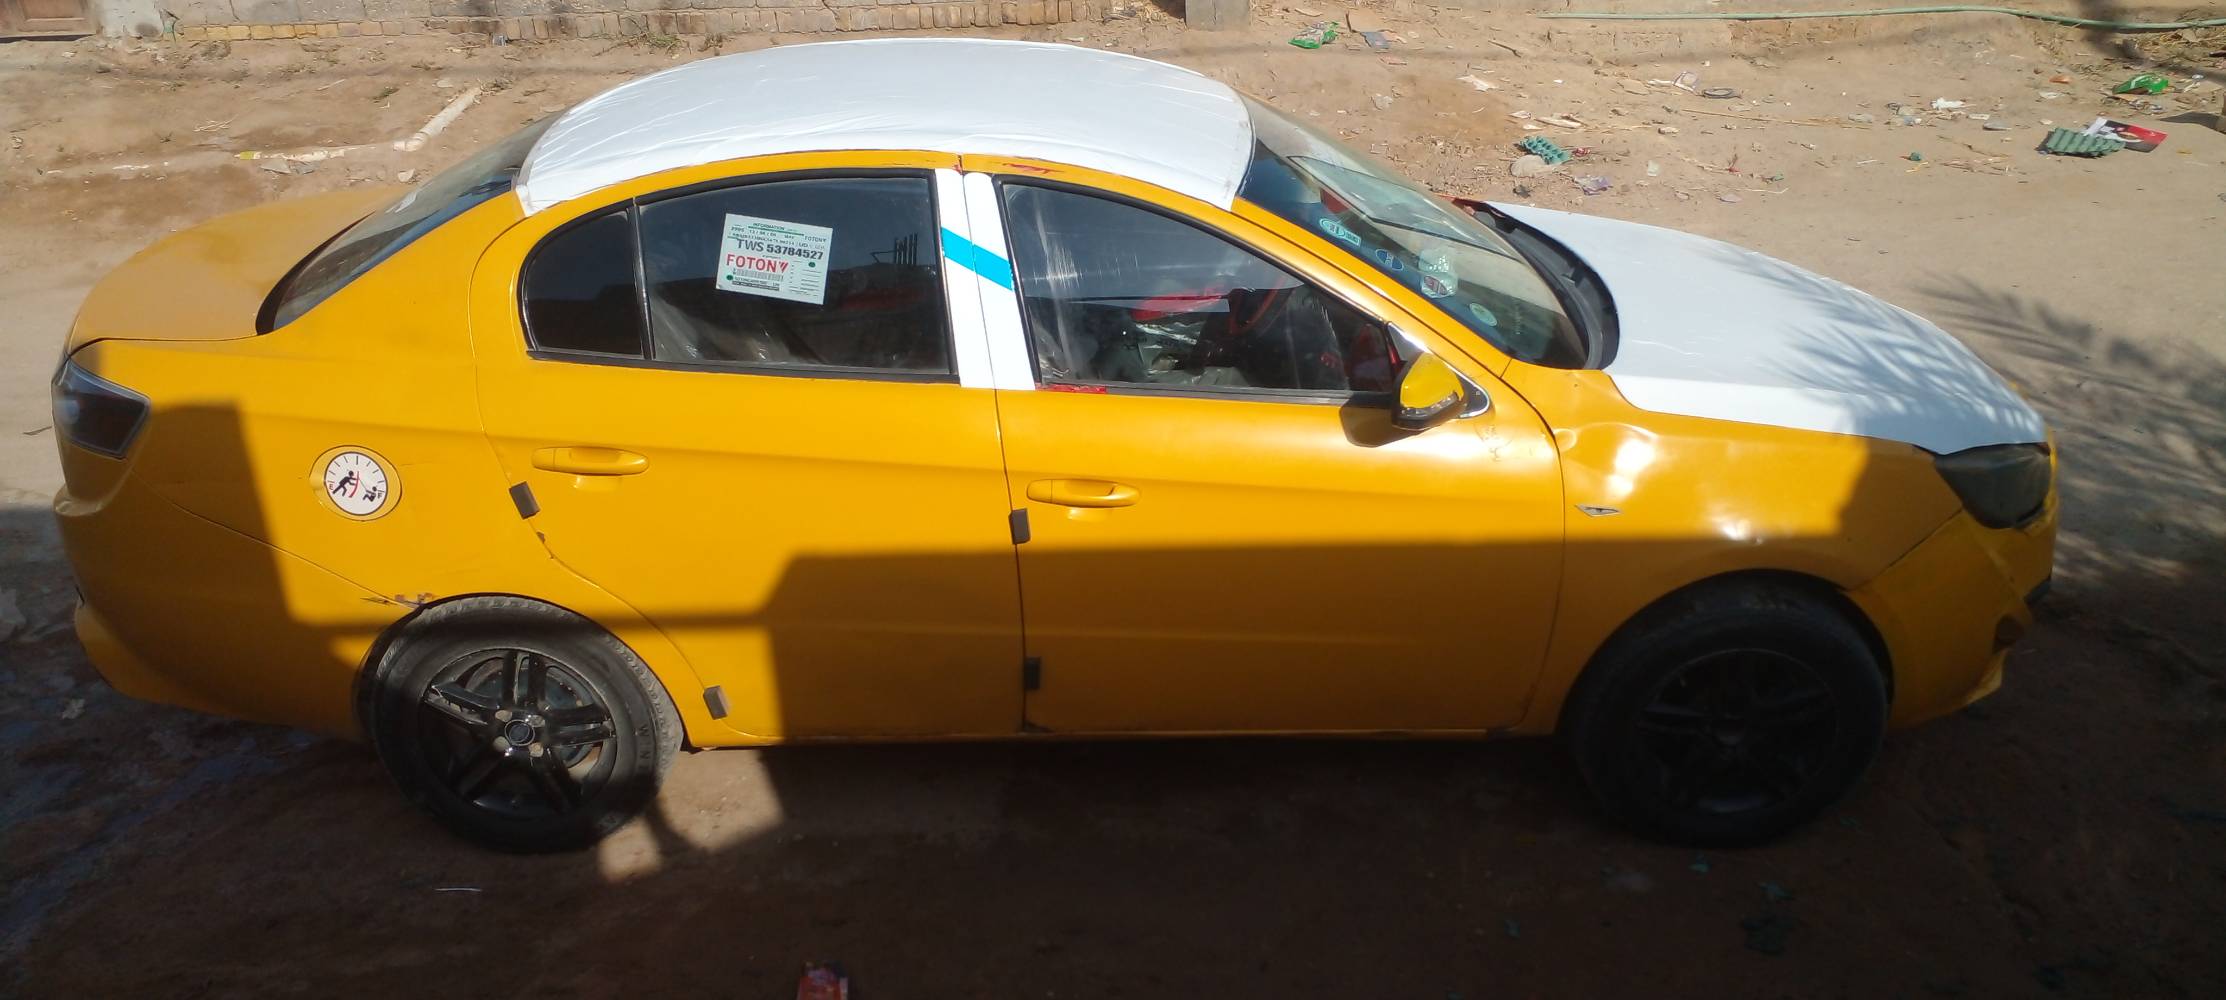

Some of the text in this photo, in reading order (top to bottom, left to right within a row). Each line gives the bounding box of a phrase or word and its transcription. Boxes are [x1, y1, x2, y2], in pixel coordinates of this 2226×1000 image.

[737, 239, 764, 252] TWS
[766, 243, 824, 260] 53784527
[726, 254, 776, 273] FOTON
